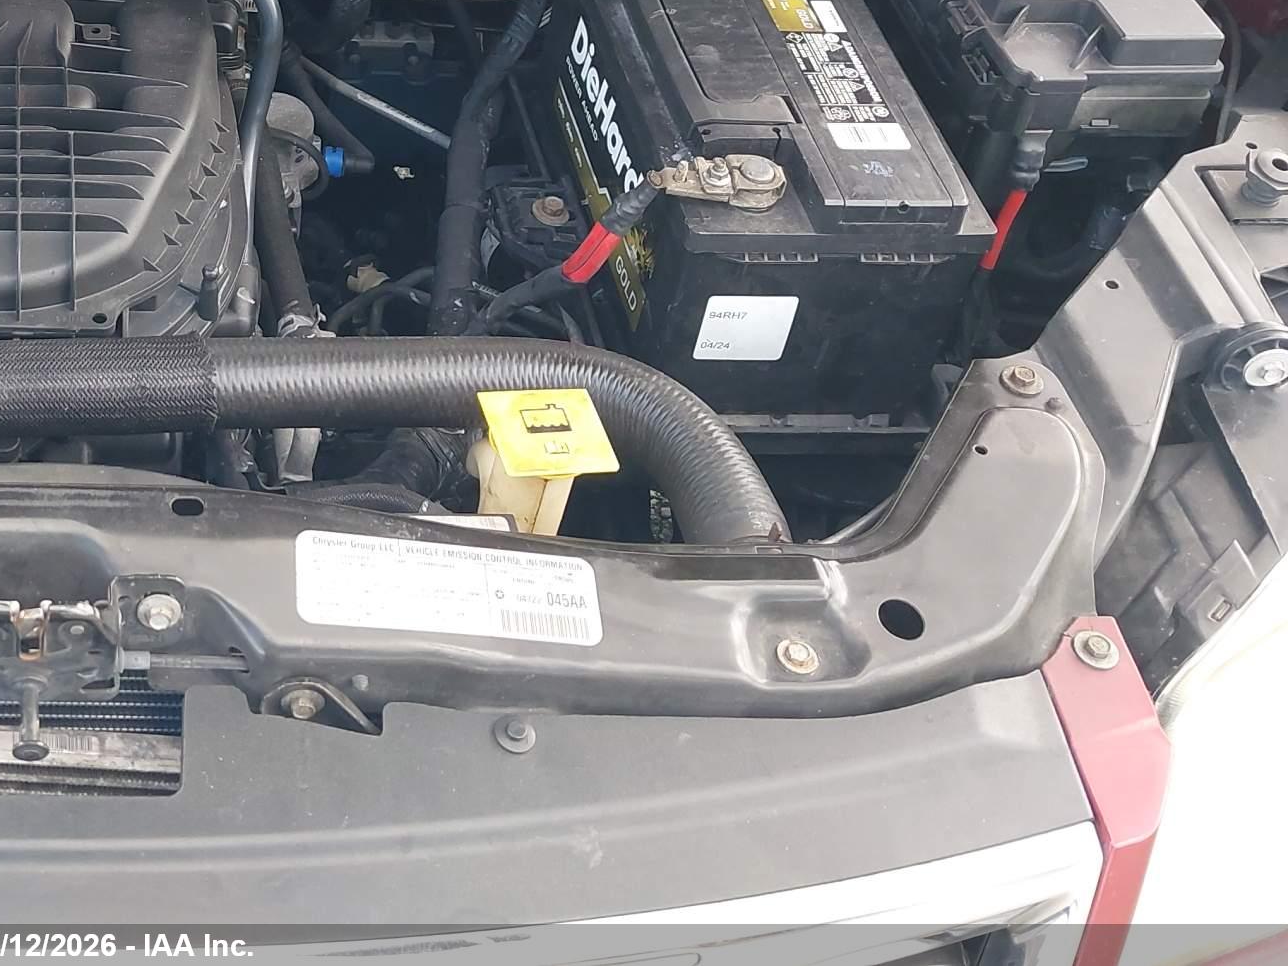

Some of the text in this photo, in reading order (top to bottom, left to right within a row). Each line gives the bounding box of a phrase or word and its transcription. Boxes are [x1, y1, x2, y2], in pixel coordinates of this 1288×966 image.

[795, 8, 814, 31] GOLD
[564, 55, 584, 100] POWER
[614, 255, 638, 312] GOLD
[700, 340, 730, 349] 04/24
[312, 536, 395, 554] Chrysler Group LLC
[405, 545, 584, 572] VEHICLE EMISSION CONTROL INFORMATION
[546, 591, 588, 610] 045AA
